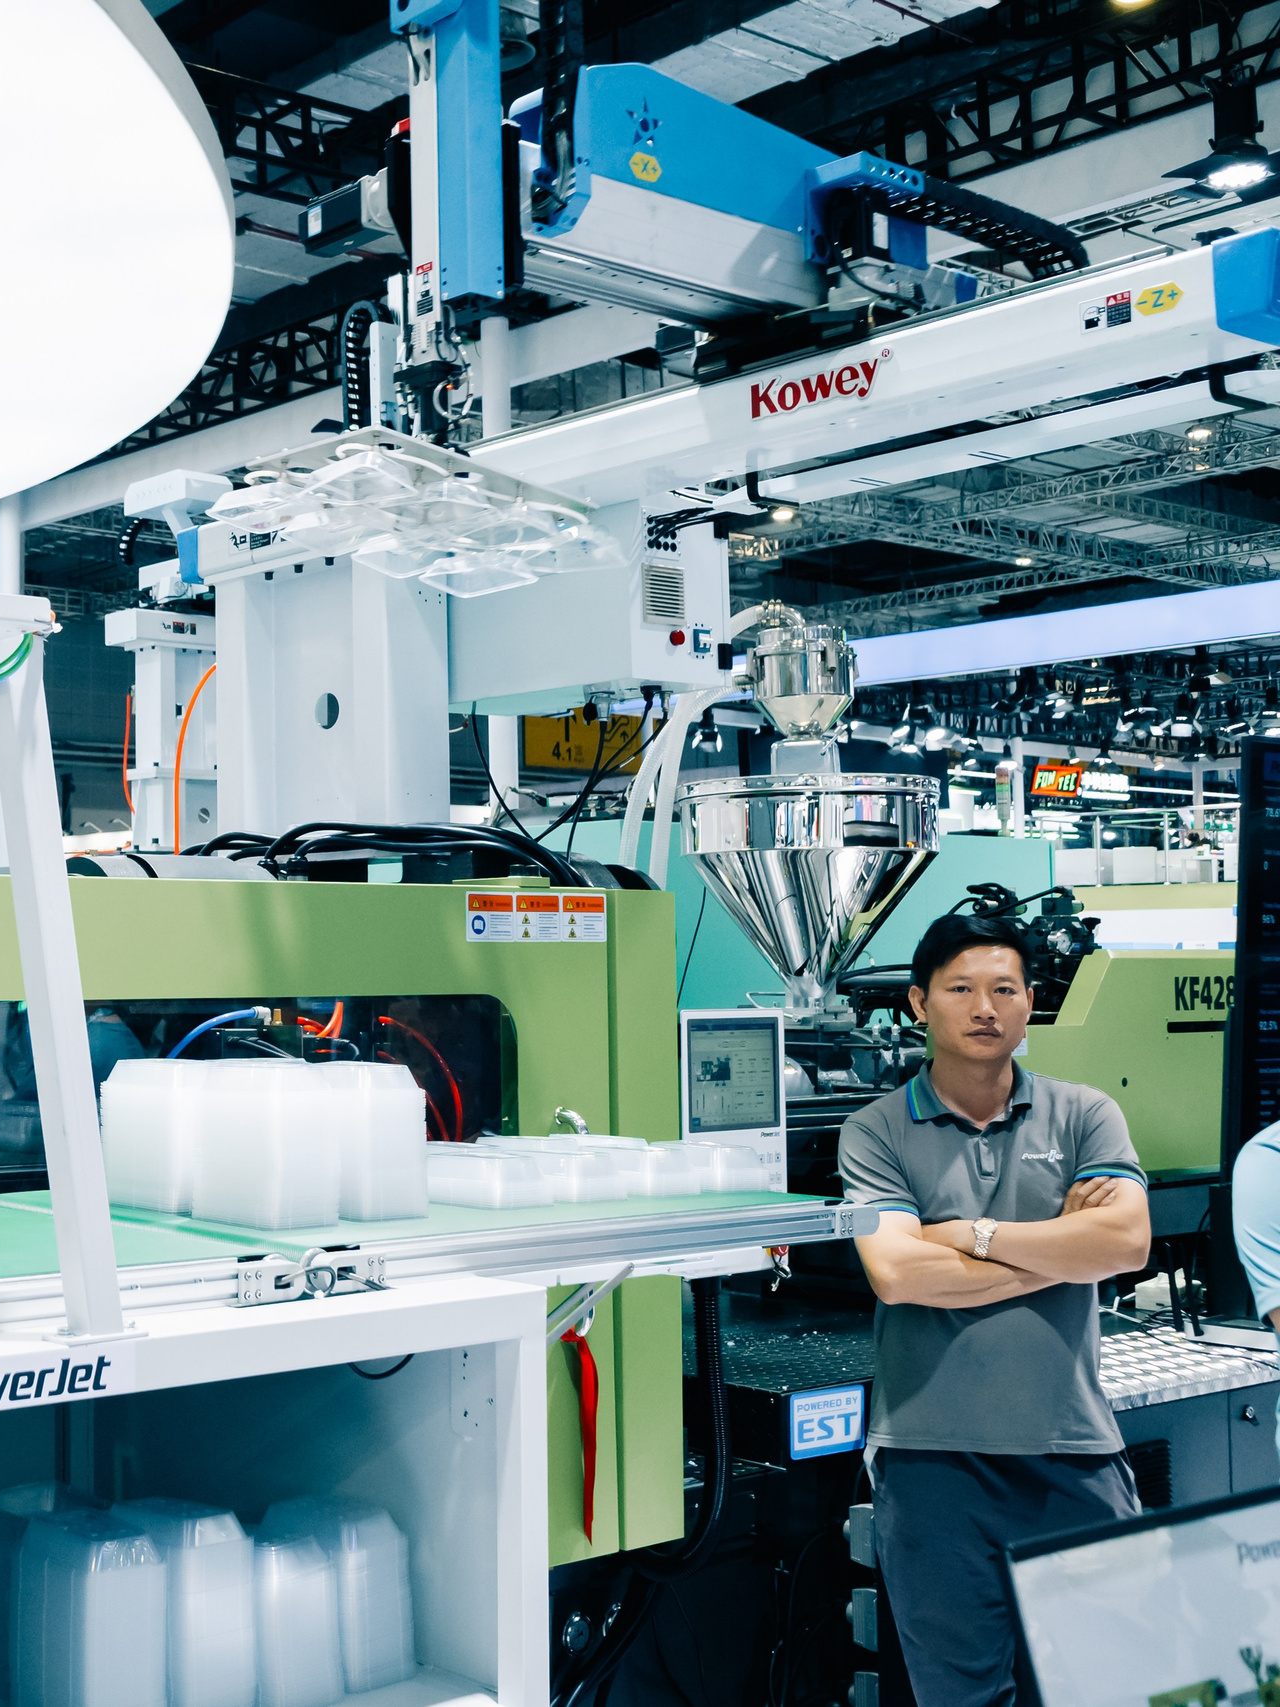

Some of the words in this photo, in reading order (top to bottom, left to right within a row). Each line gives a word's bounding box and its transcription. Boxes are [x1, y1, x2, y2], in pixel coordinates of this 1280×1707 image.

[750, 358, 879, 419] Kowey
[797, 1398, 842, 1413] POWERED
[845, 1395, 858, 1406] BY
[797, 1411, 859, 1444] EST
